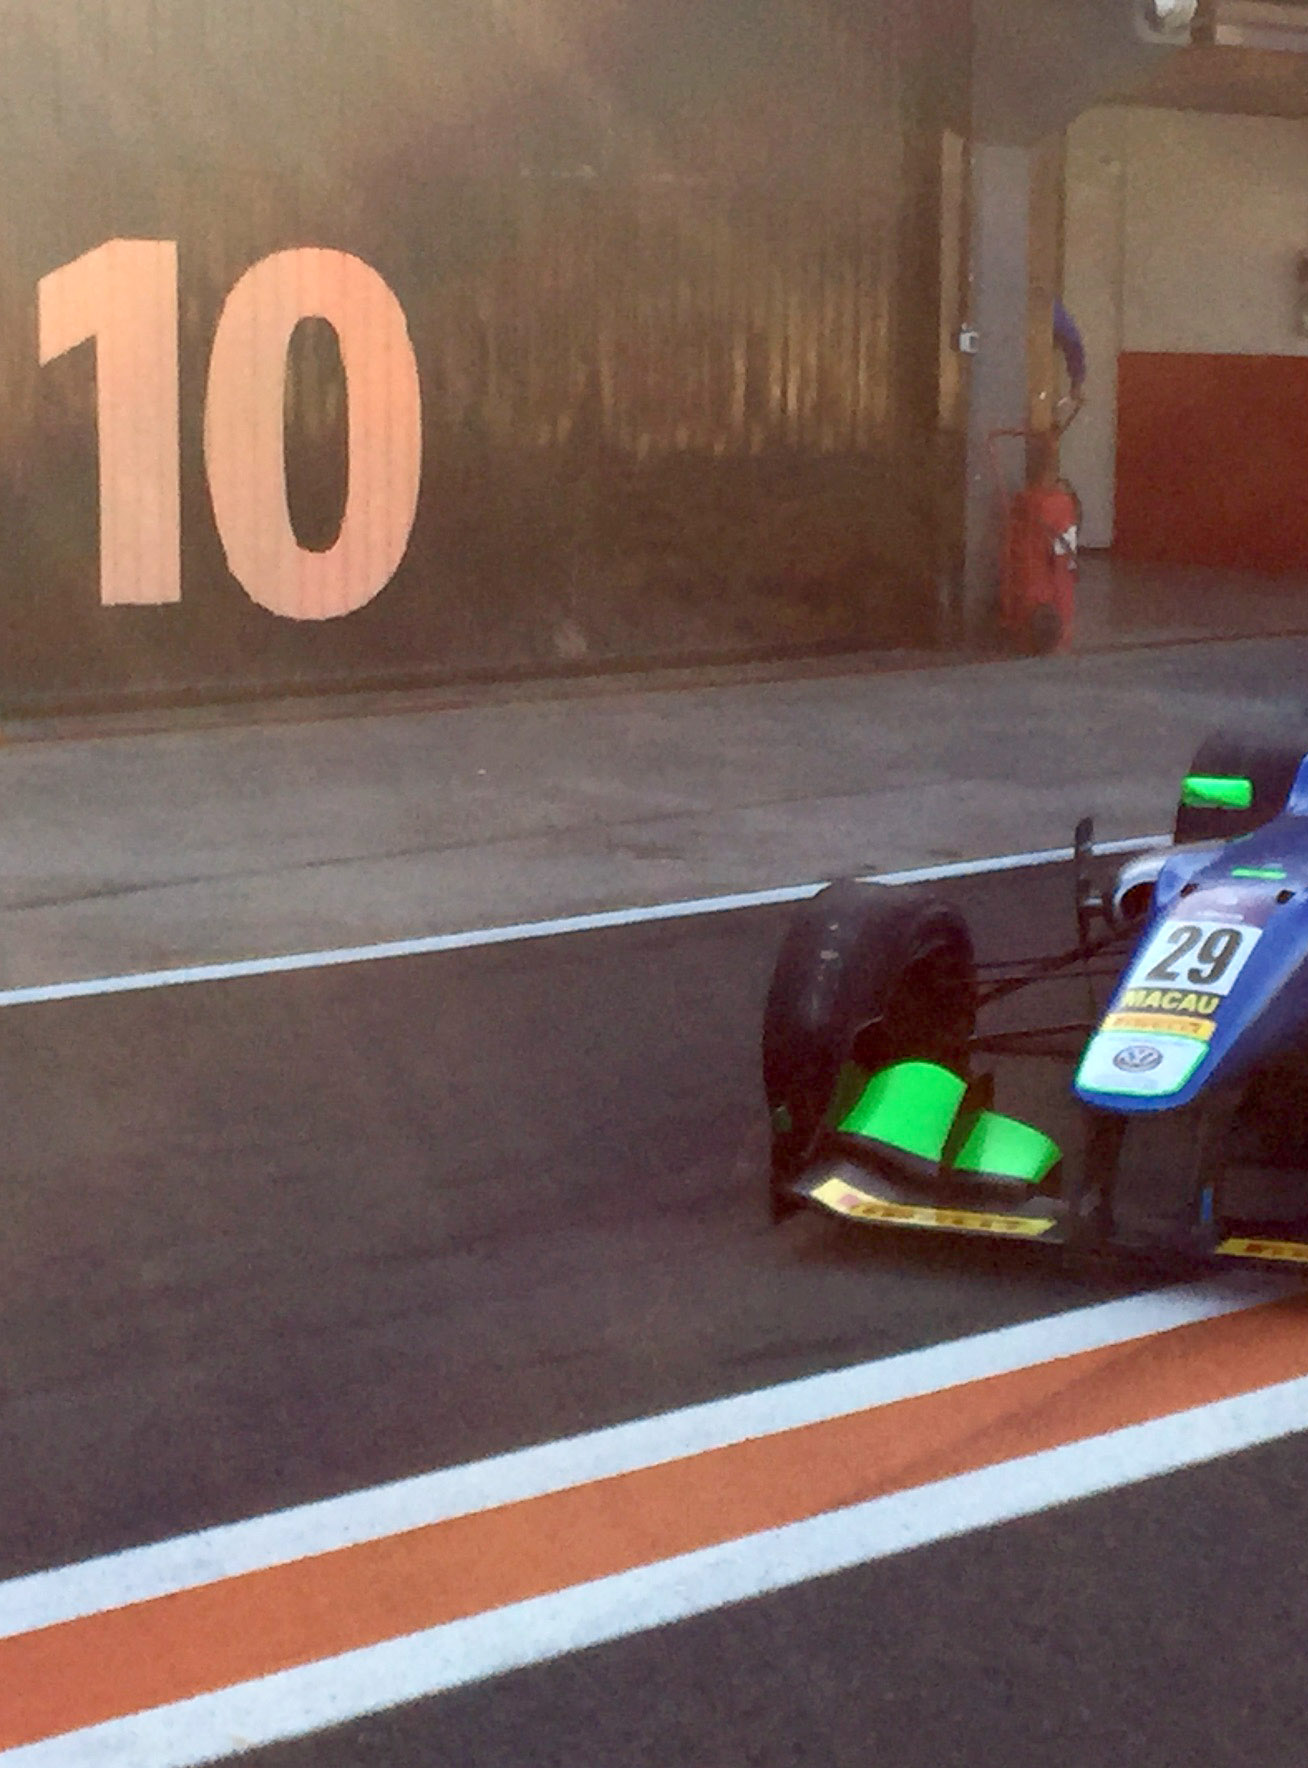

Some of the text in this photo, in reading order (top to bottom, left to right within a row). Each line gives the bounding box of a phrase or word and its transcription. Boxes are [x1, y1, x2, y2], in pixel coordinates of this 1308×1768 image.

[37, 237, 423, 620] 10
[1145, 926, 1243, 985] 29
[1123, 990, 1220, 1014] MACAU
